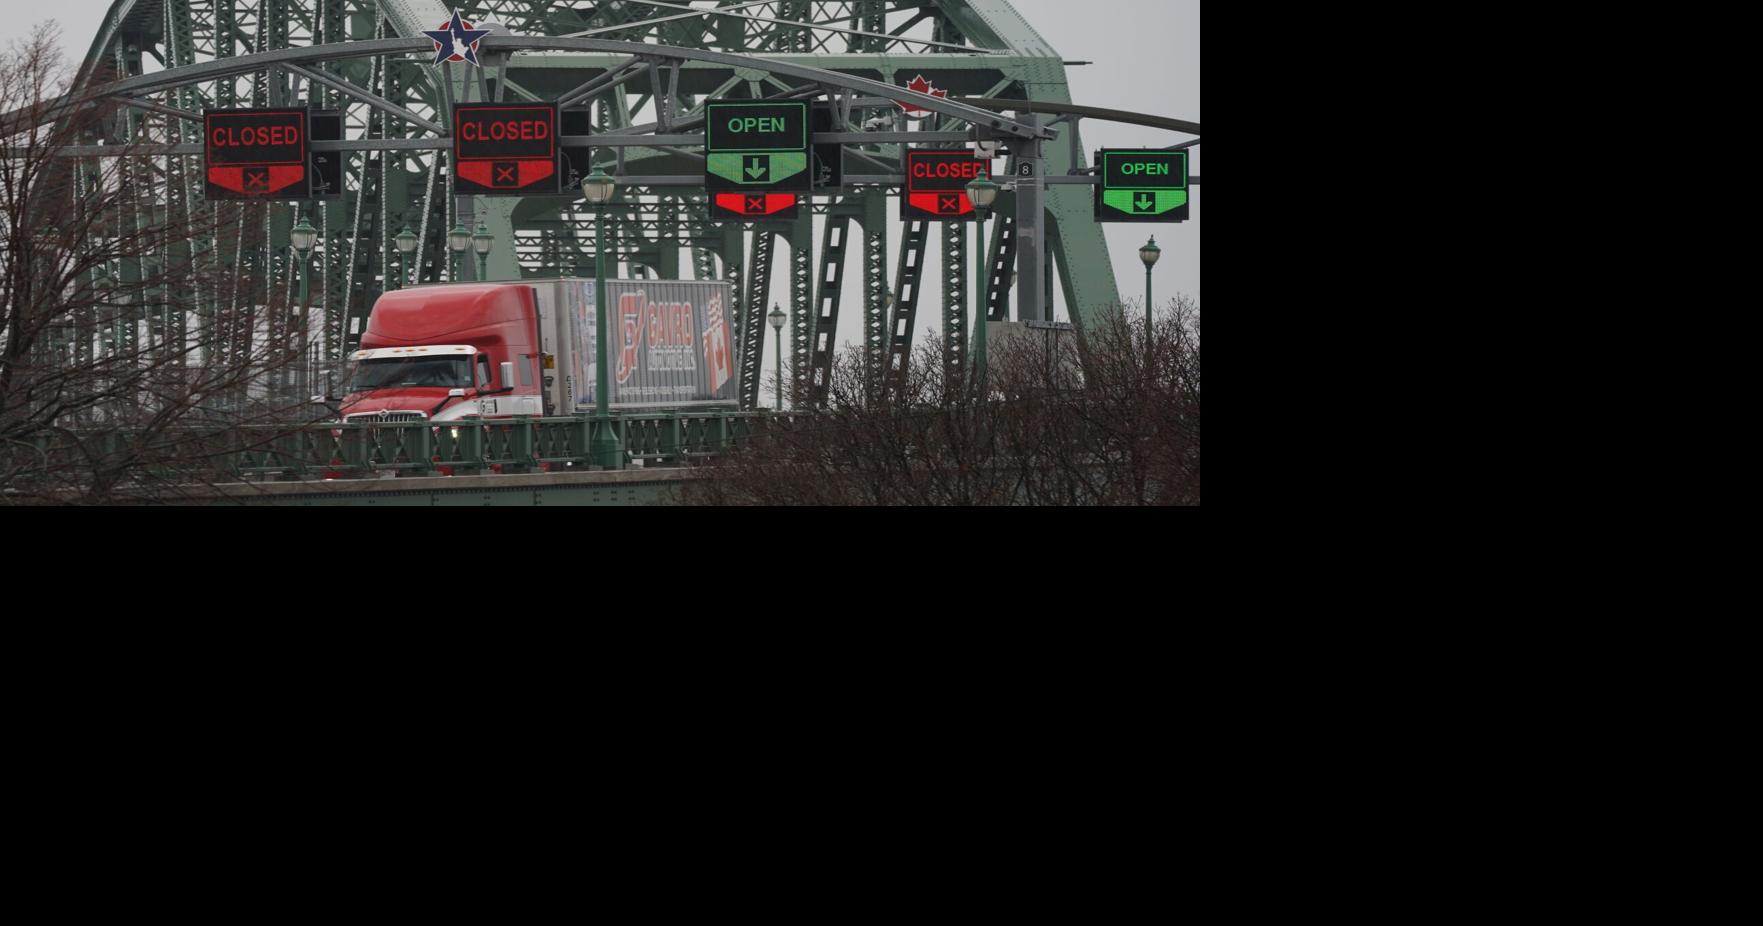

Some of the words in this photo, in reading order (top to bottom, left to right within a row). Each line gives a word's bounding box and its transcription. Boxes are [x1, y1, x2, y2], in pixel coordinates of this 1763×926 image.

[462, 120, 548, 142] CLOSED
[727, 116, 786, 134] OPEN
[211, 125, 299, 147] CLOSED
[1022, 165, 1029, 175] 8
[1120, 162, 1169, 176] OPEN
